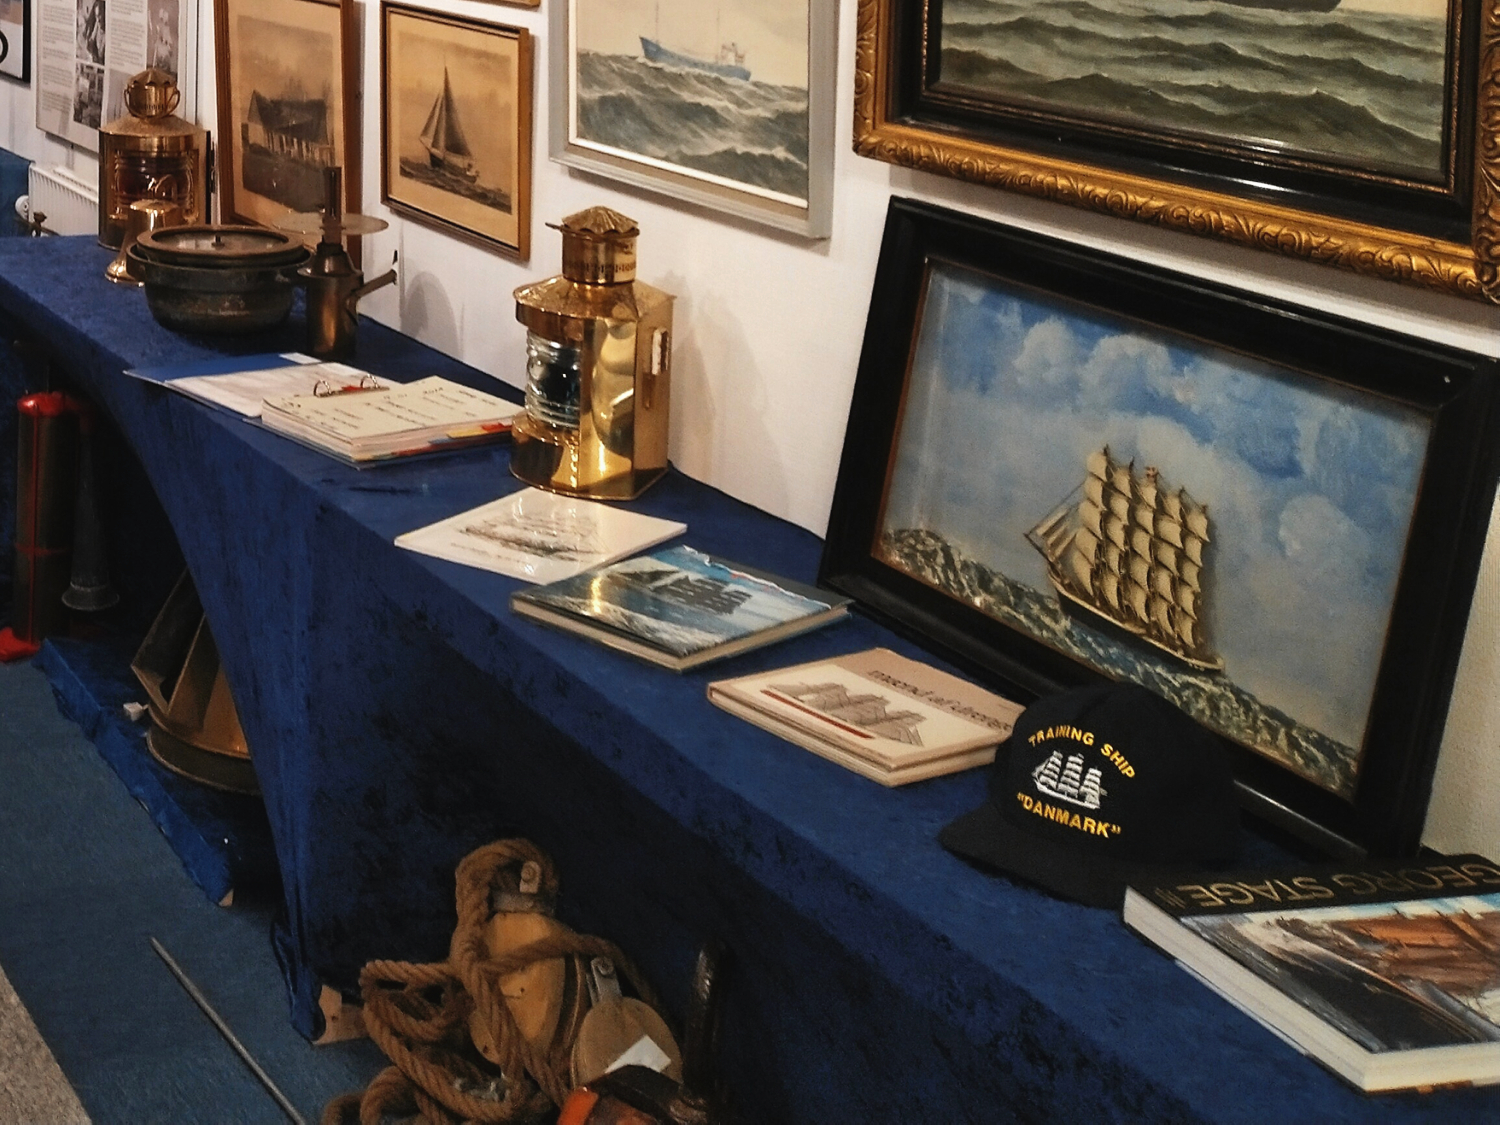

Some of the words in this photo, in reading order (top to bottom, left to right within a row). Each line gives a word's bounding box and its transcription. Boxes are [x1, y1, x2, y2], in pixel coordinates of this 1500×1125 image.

[1028, 724, 1095, 748] TRAINING
[1100, 743, 1136, 778] SHIP
[1332, 863, 1500, 895] GEORG
